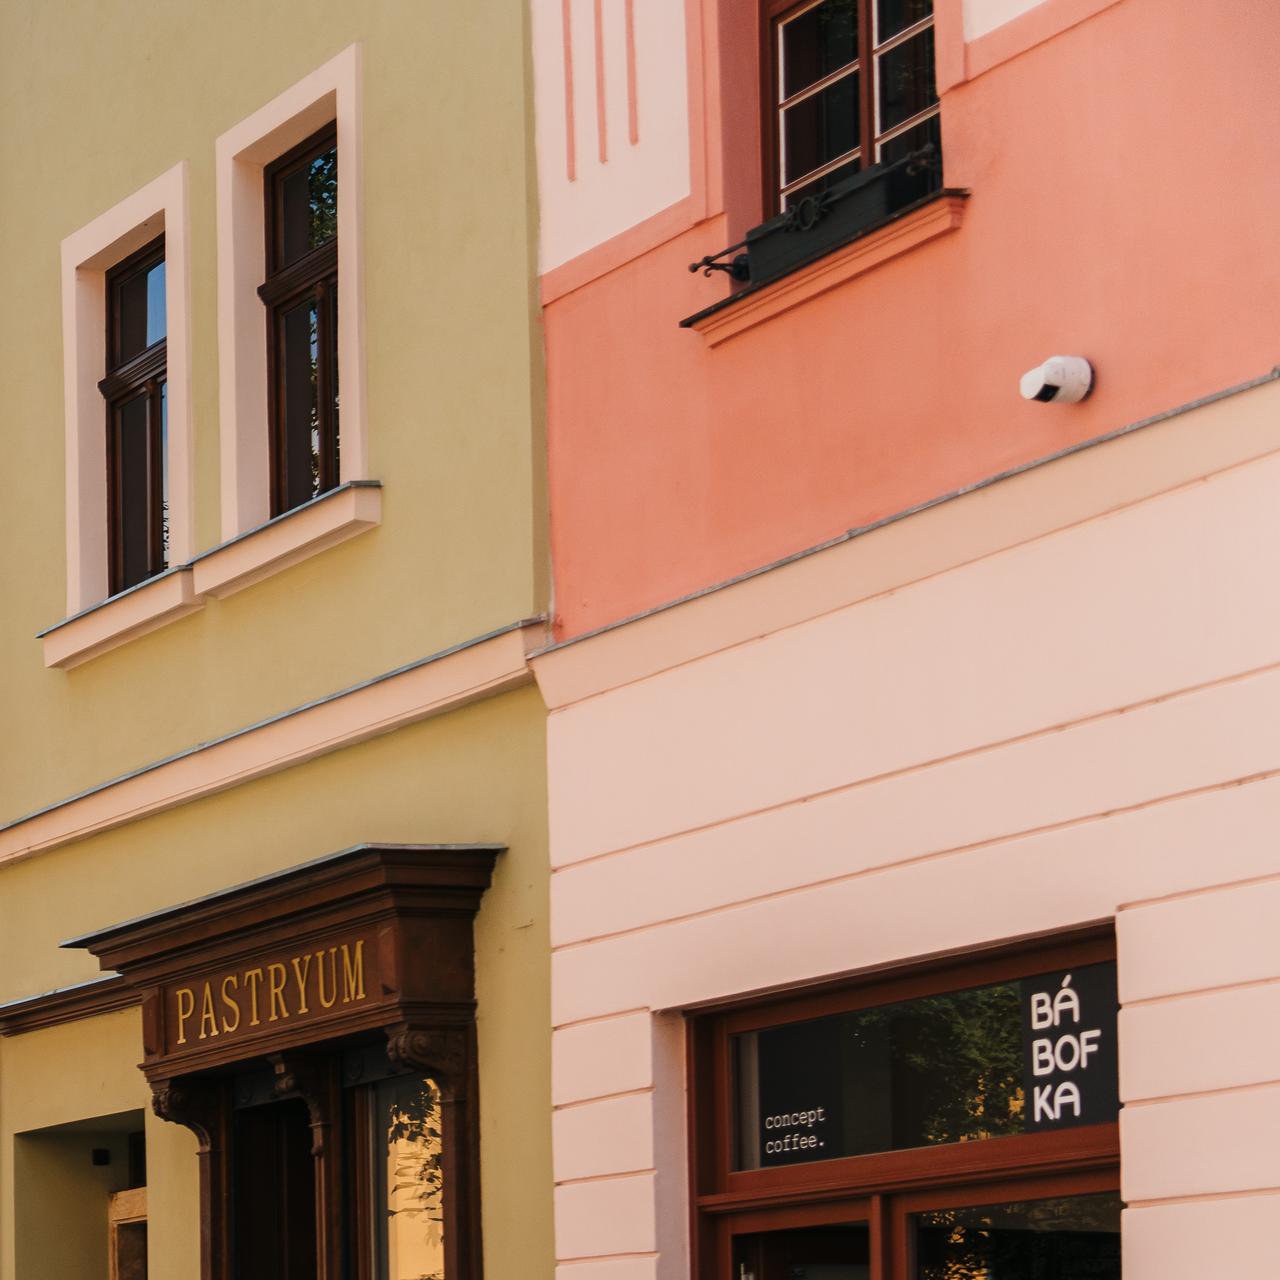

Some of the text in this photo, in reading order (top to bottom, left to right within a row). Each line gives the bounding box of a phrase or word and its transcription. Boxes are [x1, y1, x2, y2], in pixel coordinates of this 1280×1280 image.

[175, 940, 366, 1045] PASTRYUM
[1031, 974, 1080, 1030] BÁ
[1032, 1029, 1102, 1076] BOF
[765, 1106, 826, 1129] concept
[1033, 1081, 1081, 1123] KA
[766, 1133, 825, 1154] coffee.
